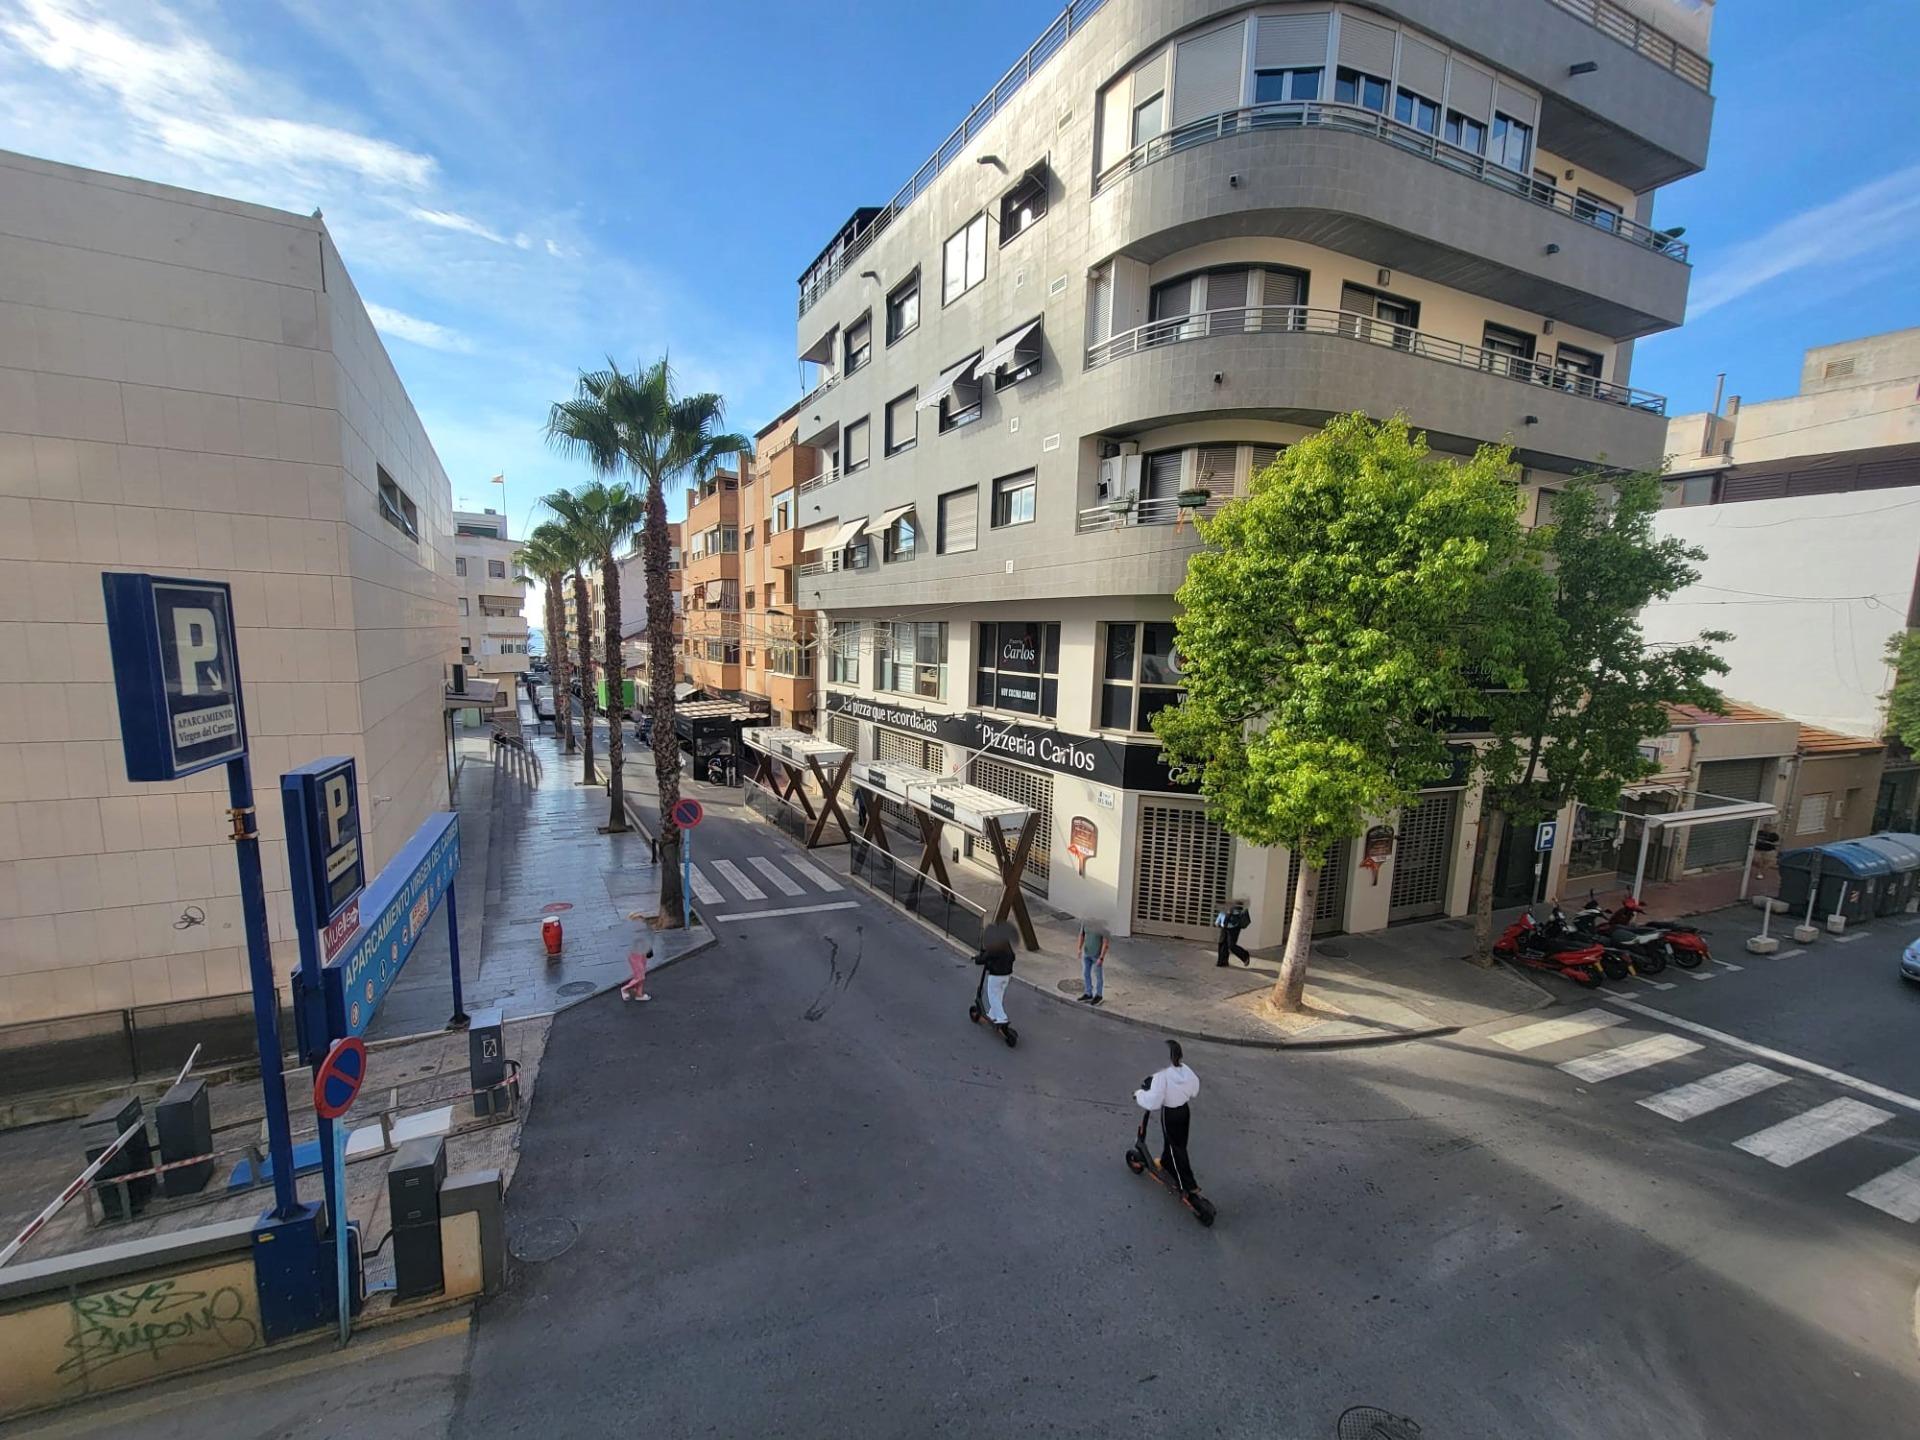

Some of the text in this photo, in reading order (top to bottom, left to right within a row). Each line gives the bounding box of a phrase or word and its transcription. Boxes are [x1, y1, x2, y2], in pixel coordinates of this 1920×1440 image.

[172, 607, 218, 696] P
[1003, 643, 1035, 661] Carlos
[178, 709, 233, 729] APARCAMIENTO
[852, 700, 872, 717] pizza
[872, 706, 886, 723] que
[887, 710, 938, 734] recordabas
[982, 724, 1095, 771] Pizzería Carlos
[324, 774, 349, 849] P
[1540, 825, 1554, 848] P
[345, 887, 410, 992] APARCAMIENTO
